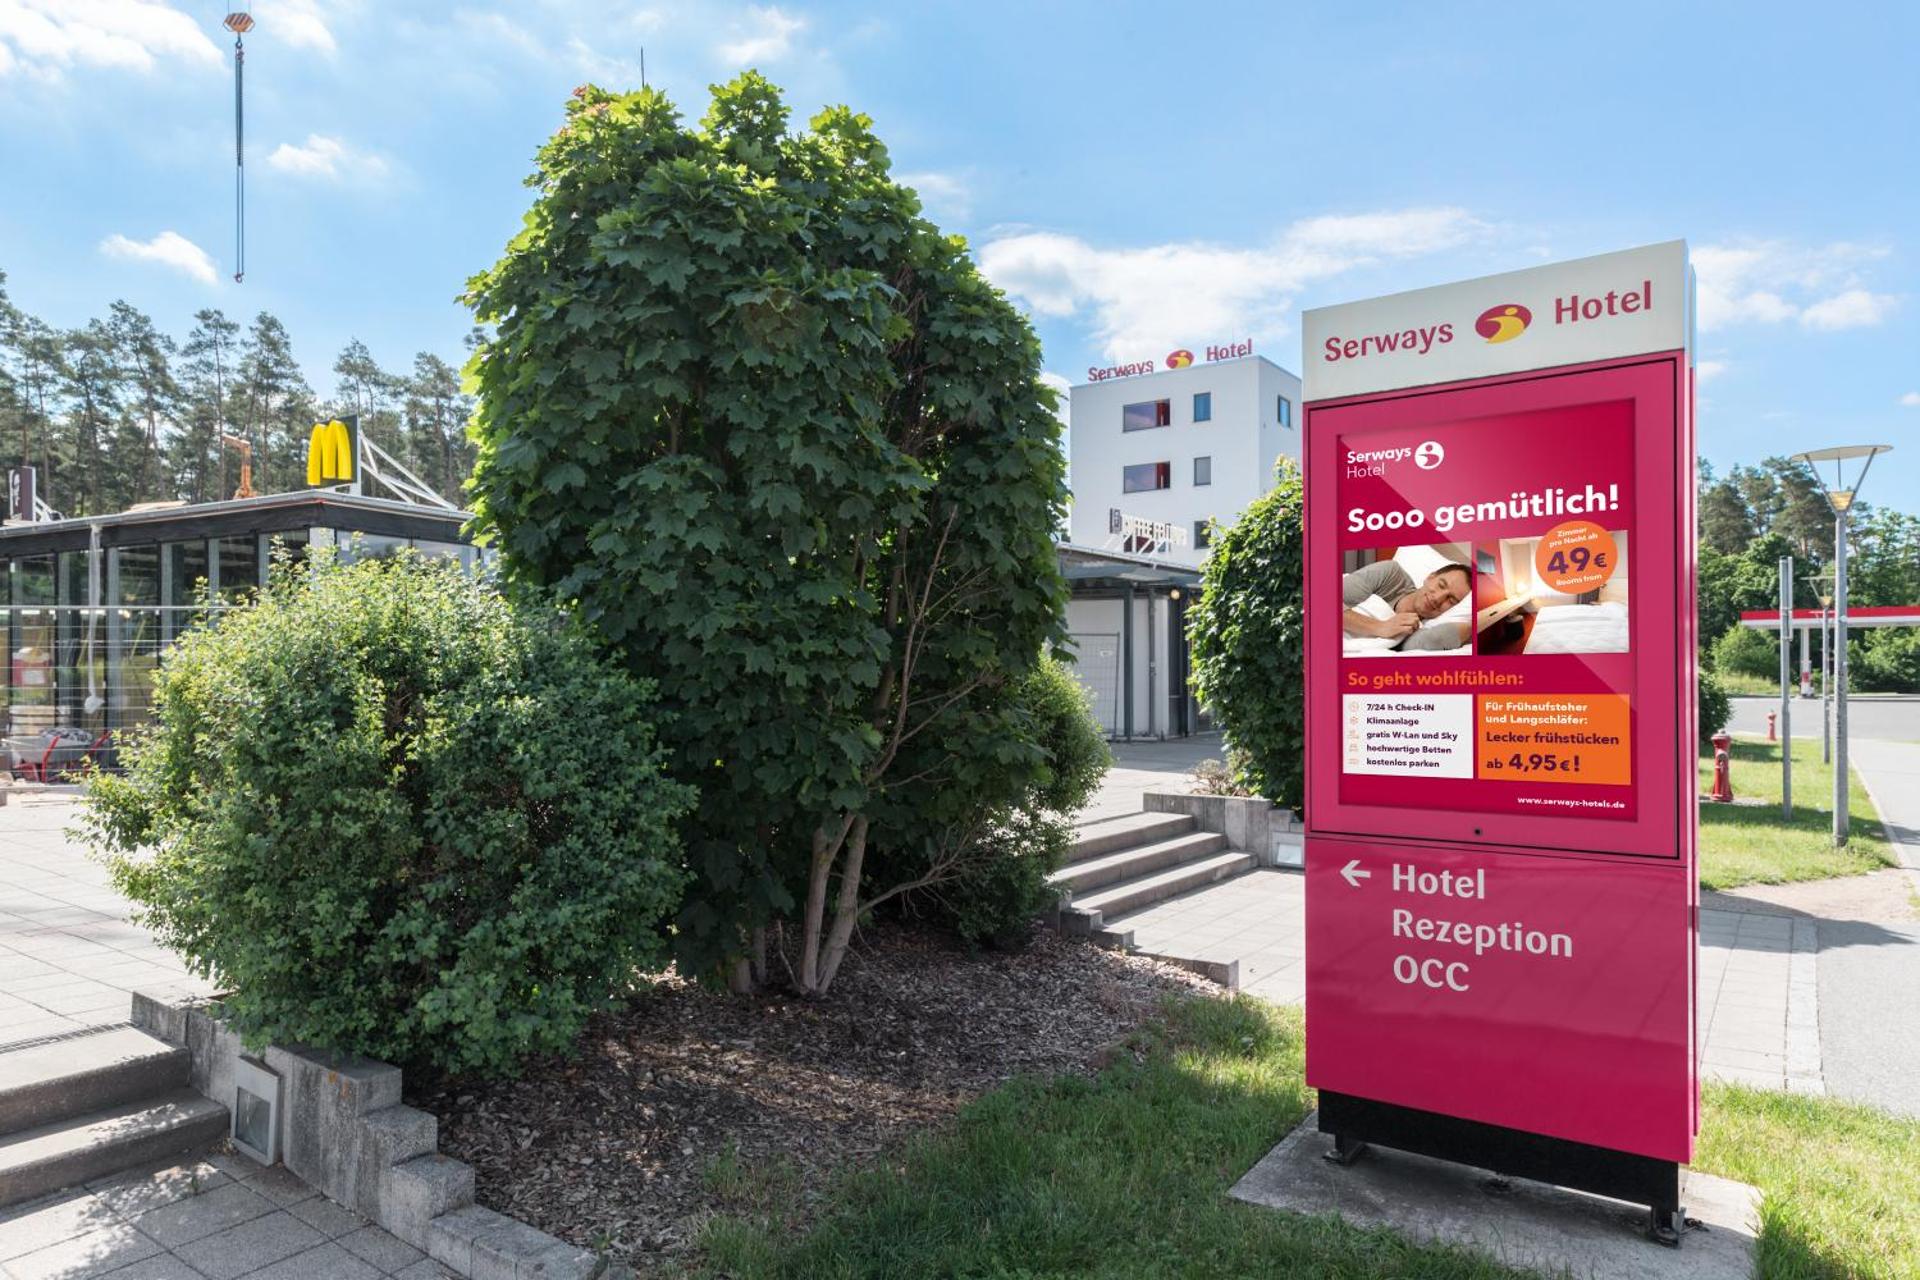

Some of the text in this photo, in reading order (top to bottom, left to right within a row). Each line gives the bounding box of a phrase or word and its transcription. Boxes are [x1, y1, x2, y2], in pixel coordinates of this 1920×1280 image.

[1324, 280, 1651, 362] Serways Hotel
[1088, 338, 1252, 382] Serways Hotel
[1347, 446, 1411, 464] Serways
[1347, 462, 1385, 479] Hotel
[1347, 483, 1619, 533] Sooo gemütlich!
[1557, 527, 1587, 537] Zimmer
[1549, 539, 1563, 548] pro
[1564, 535, 1587, 545] Nacht
[1348, 669, 1524, 690] So geht wohlfühlen:
[1366, 703, 1435, 712] 7/24 h Check-IN
[1485, 701, 1588, 712] Für Frühaufsteher
[1366, 716, 1420, 727] Klimaanlage
[1485, 714, 1588, 727] und Langschläfer:
[1366, 731, 1458, 742] gratis W-Lan und Sky
[1486, 731, 1619, 745] Lecker frühstücken
[1366, 744, 1452, 755] hochwertige Betten
[1366, 758, 1440, 769] kostenlos parken
[1486, 758, 1503, 769] ab
[1517, 796, 1626, 809] www.serways-hotels.de
[1392, 863, 1485, 899] Hotel
[1393, 908, 1573, 957] Rezeption
[1393, 954, 1470, 992] OCC
